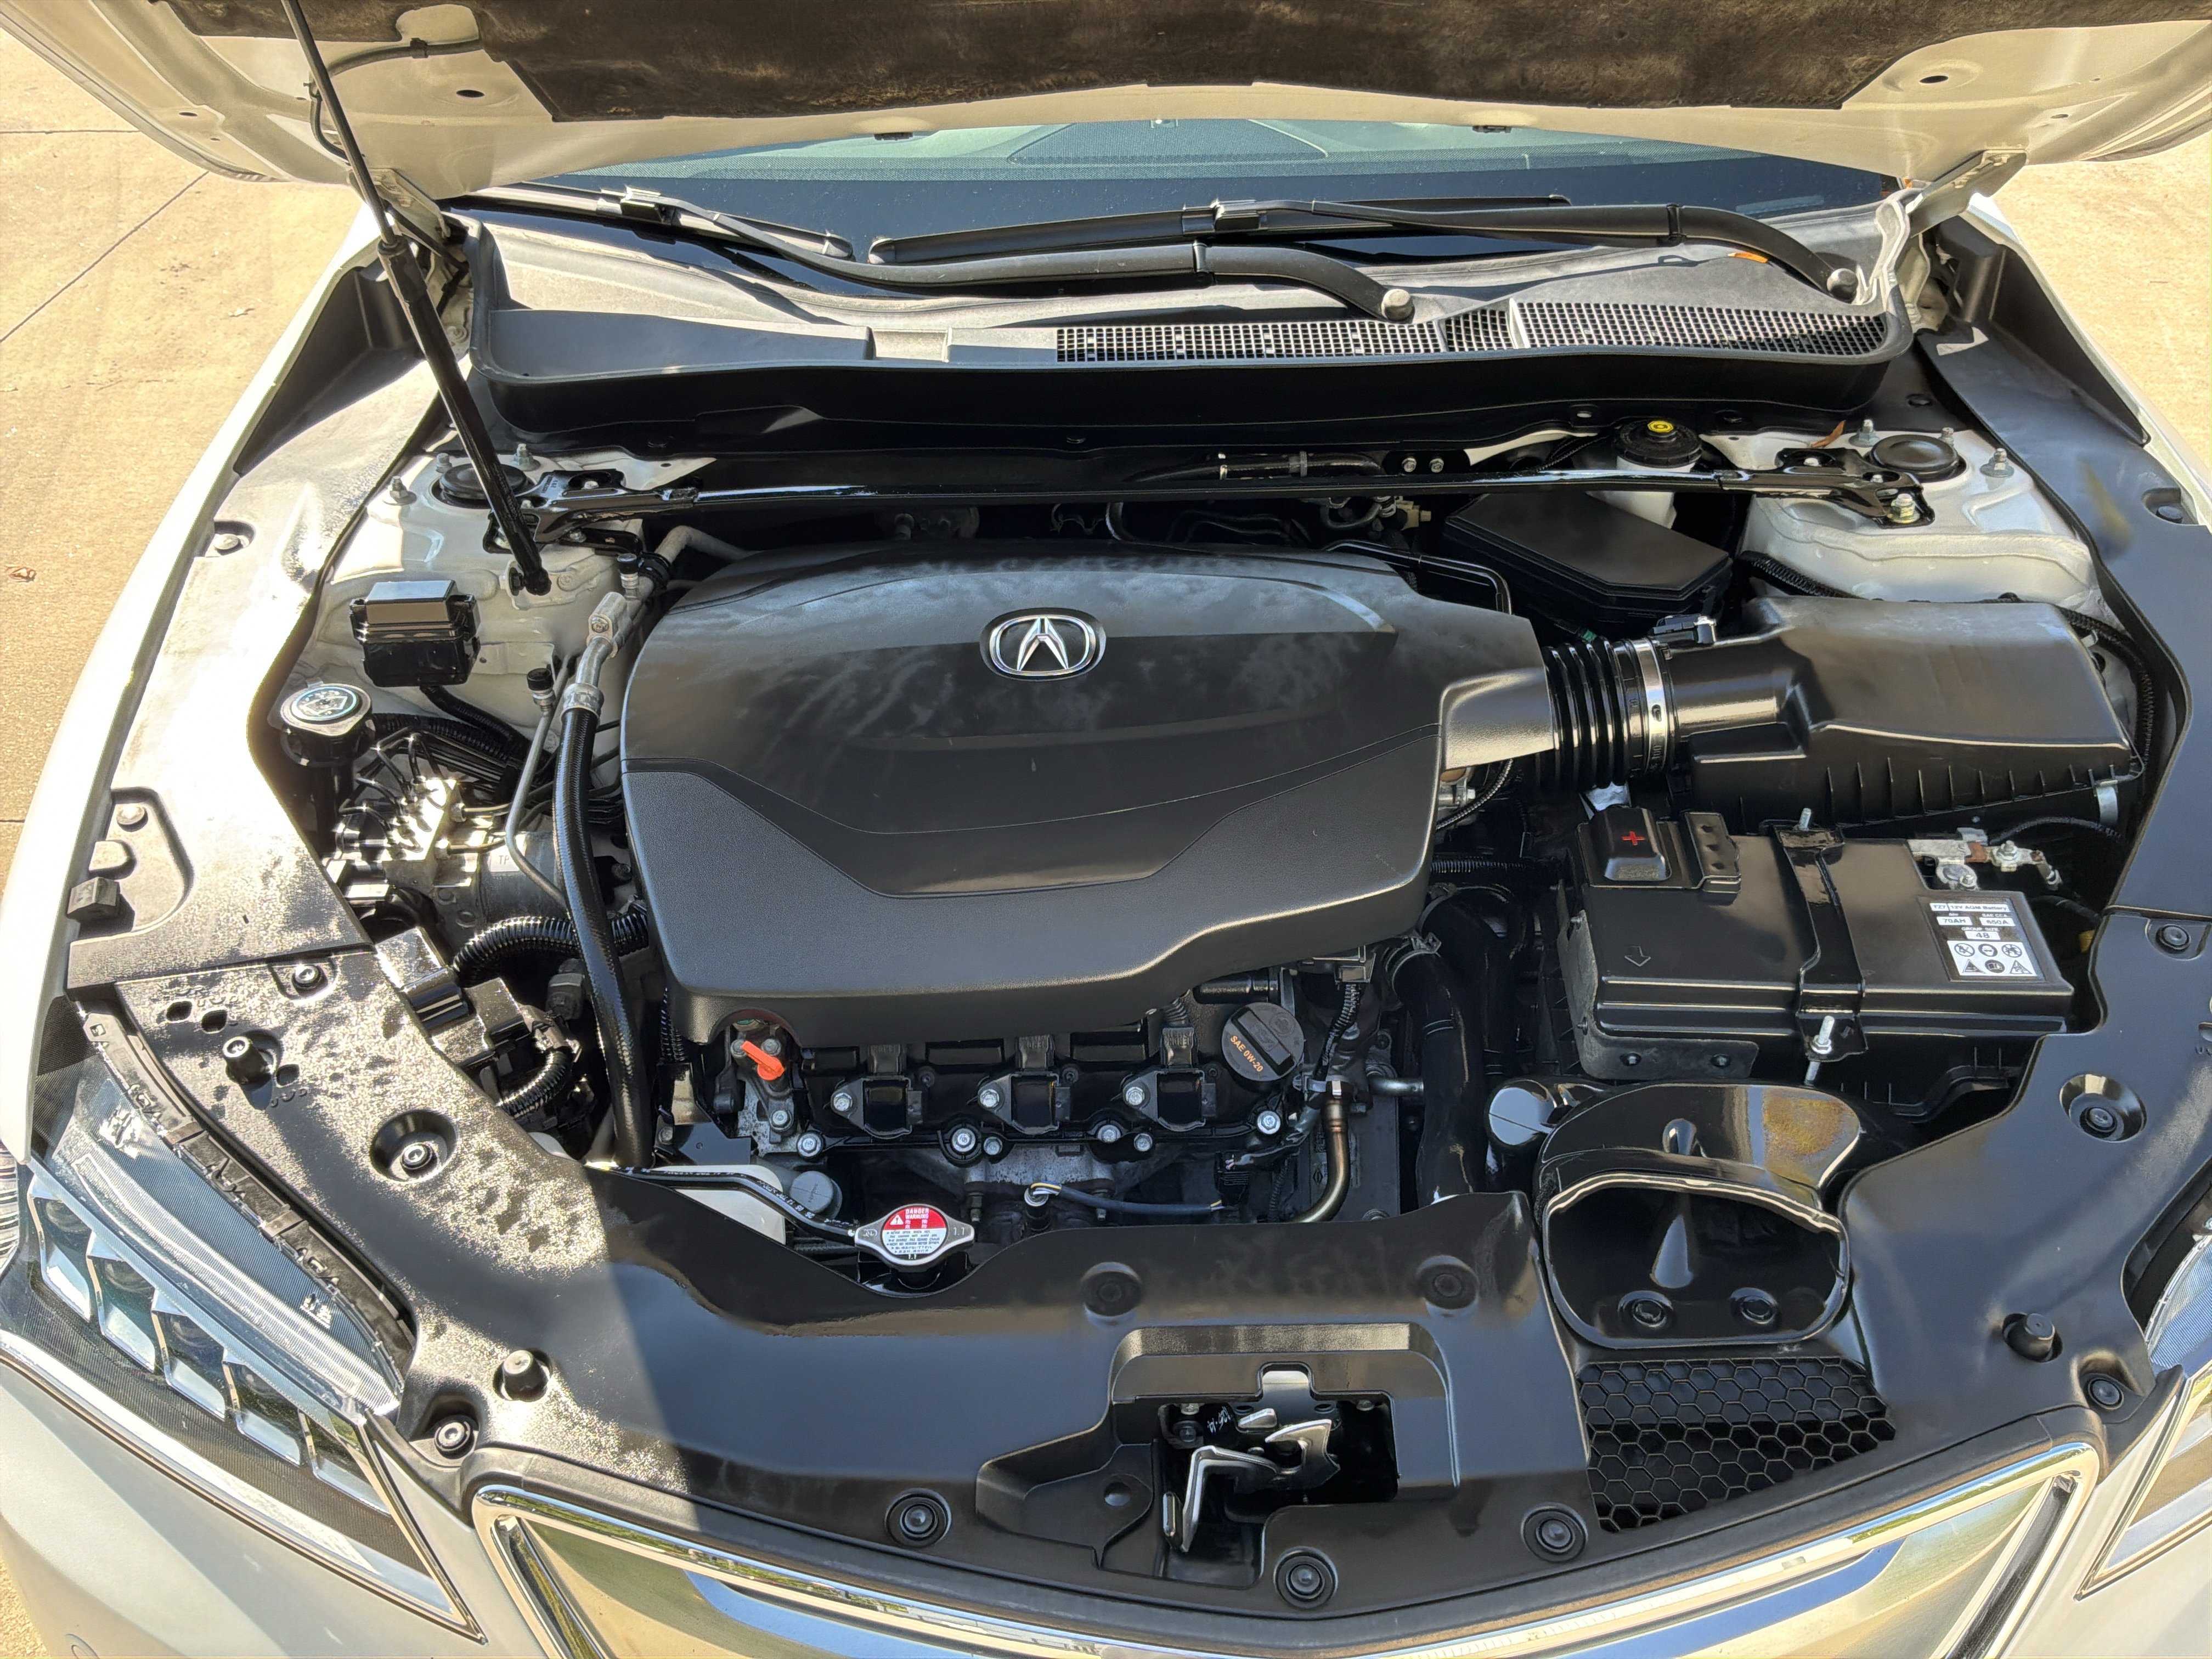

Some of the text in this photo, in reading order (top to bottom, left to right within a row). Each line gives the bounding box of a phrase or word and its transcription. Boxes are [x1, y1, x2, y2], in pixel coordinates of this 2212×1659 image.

[1231, 1035, 1263, 1072] SAE 0W-20
[953, 1226, 965, 1235] 1.1
